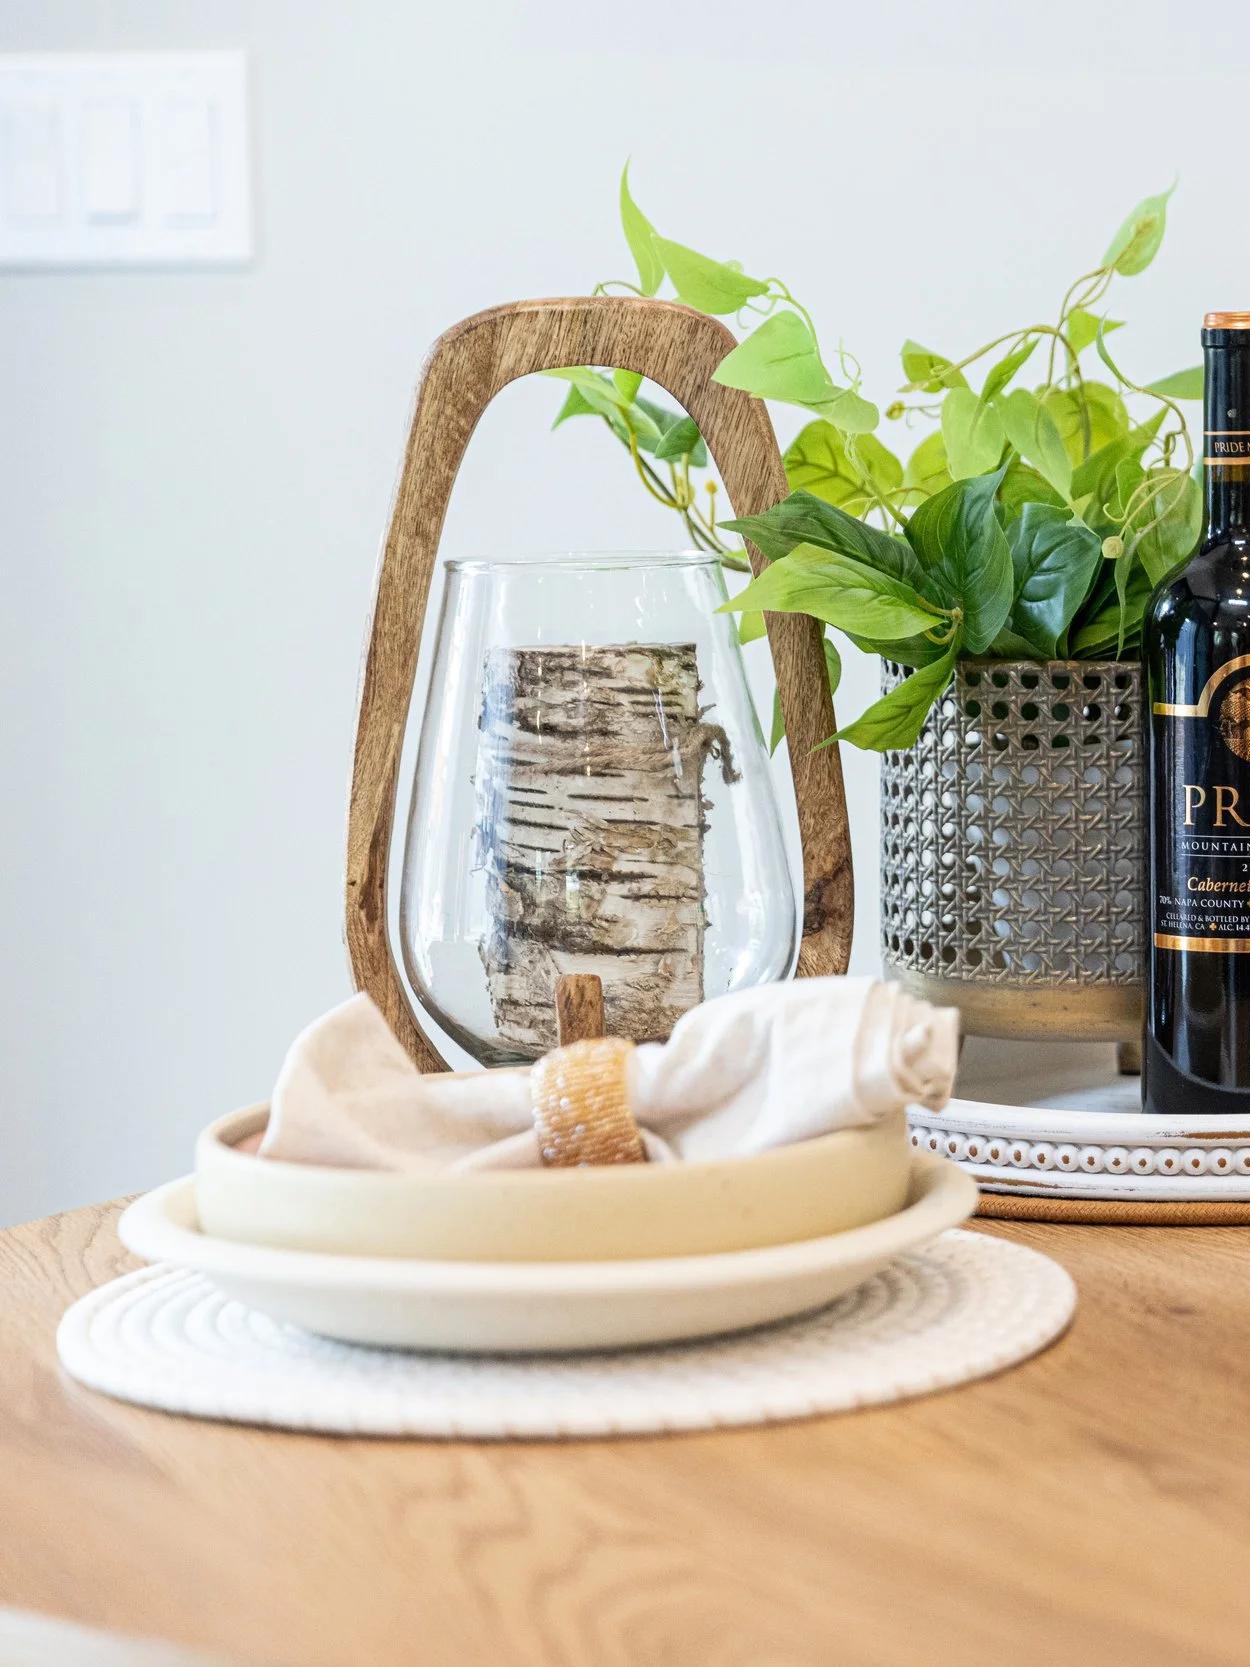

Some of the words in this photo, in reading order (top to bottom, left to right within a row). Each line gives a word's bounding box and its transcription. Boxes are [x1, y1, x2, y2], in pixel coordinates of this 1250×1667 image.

[1214, 441, 1245, 453] PRIDE
[1174, 897, 1198, 907] NAPA
[1200, 899, 1244, 908] COUNTY
[1165, 912, 1196, 921] CELLARED
[1205, 915, 1239, 923] BOTTLED
[1240, 915, 1250, 923] BY
[1218, 923, 1235, 931] ALC.
